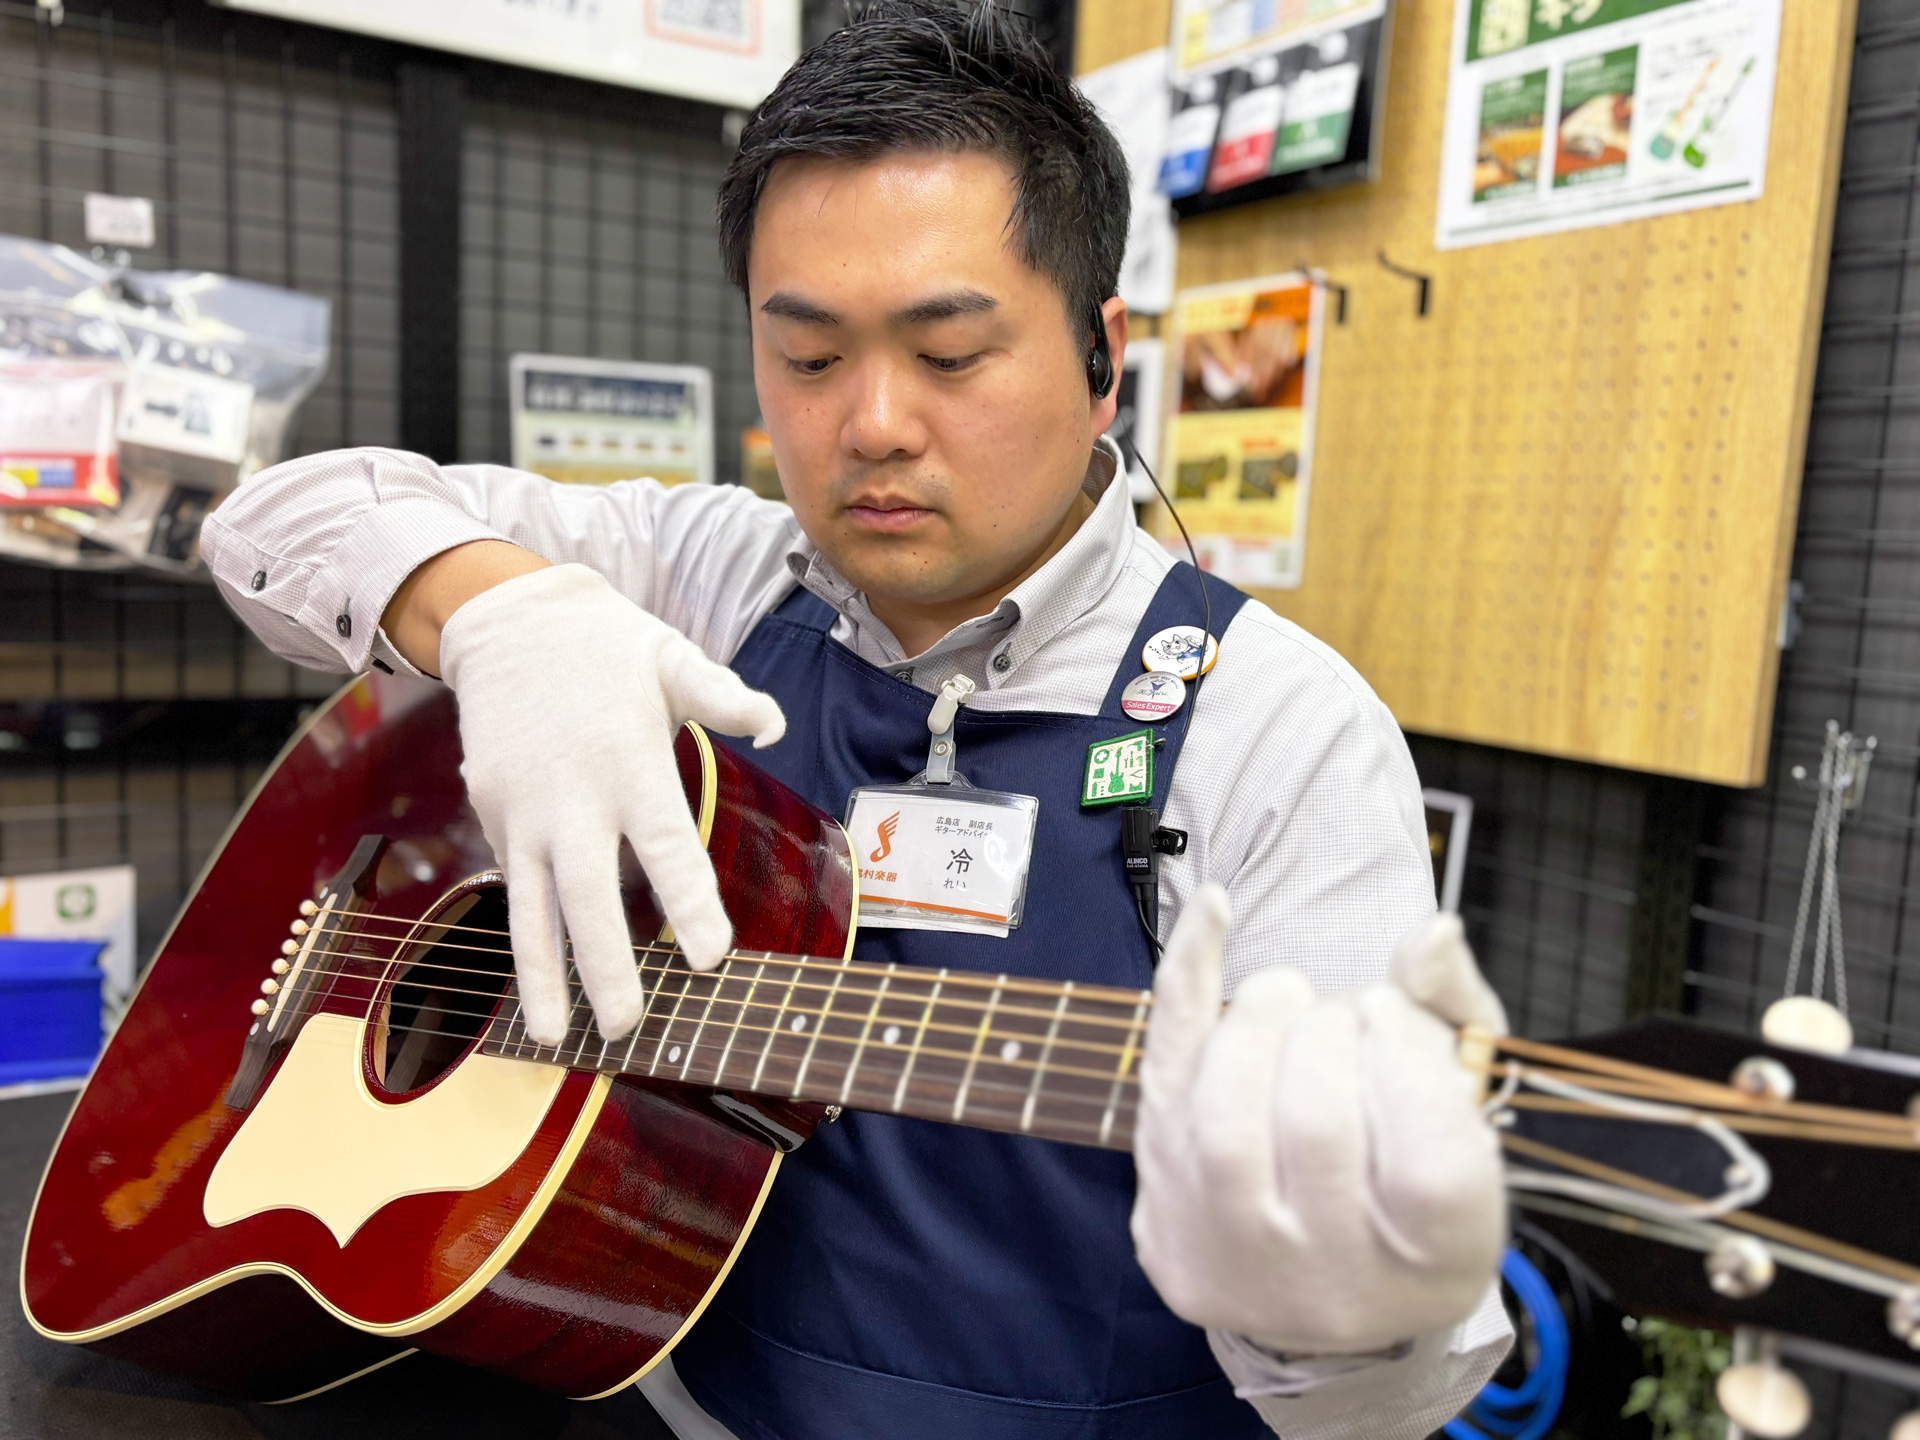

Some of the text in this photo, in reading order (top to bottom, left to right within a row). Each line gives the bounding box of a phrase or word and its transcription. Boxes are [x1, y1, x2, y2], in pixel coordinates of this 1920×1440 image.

[1126, 701, 1171, 712] Sales Expert
[936, 816, 993, 831] 広島店 副店長
[946, 848, 973, 874] 冷
[943, 877, 967, 889] れい
